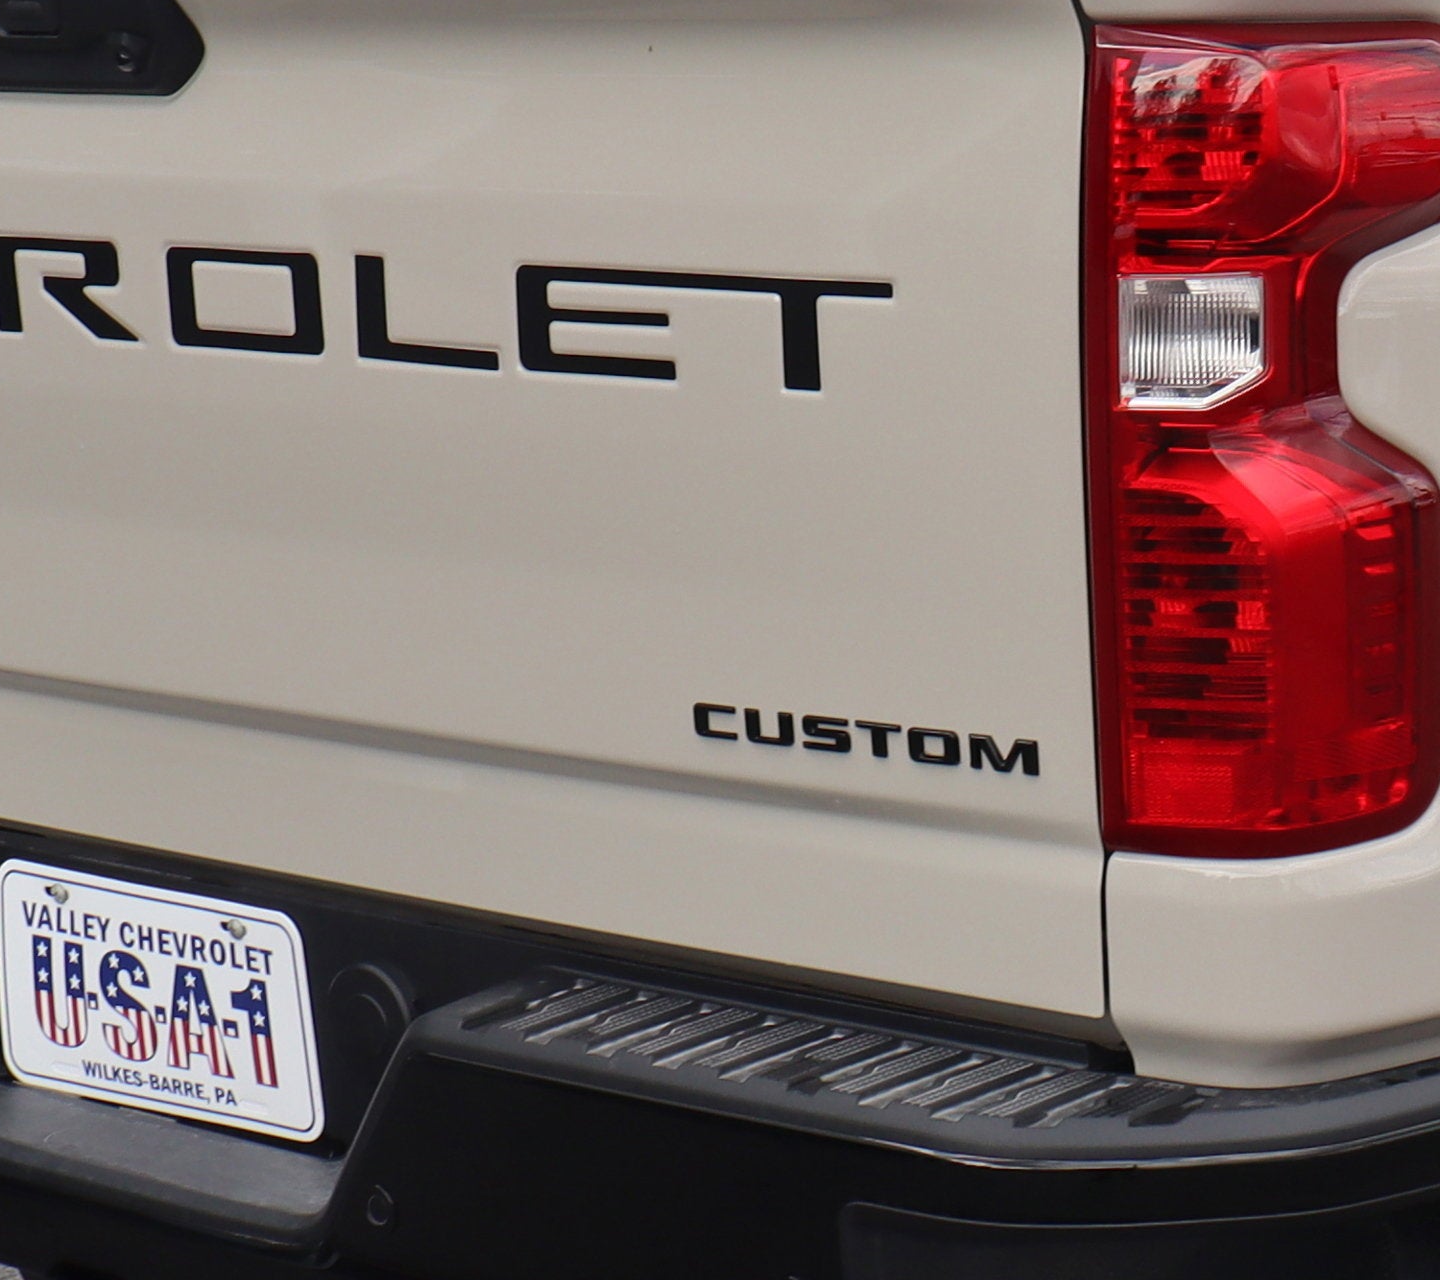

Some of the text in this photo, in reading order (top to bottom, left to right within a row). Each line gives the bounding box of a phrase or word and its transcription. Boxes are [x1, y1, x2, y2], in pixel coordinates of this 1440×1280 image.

[693, 702, 1041, 777] CUSTOM
[22, 900, 274, 976] VALLEY CHEVROLET
[81, 1059, 238, 1107] WILKES-BARRE, PA
